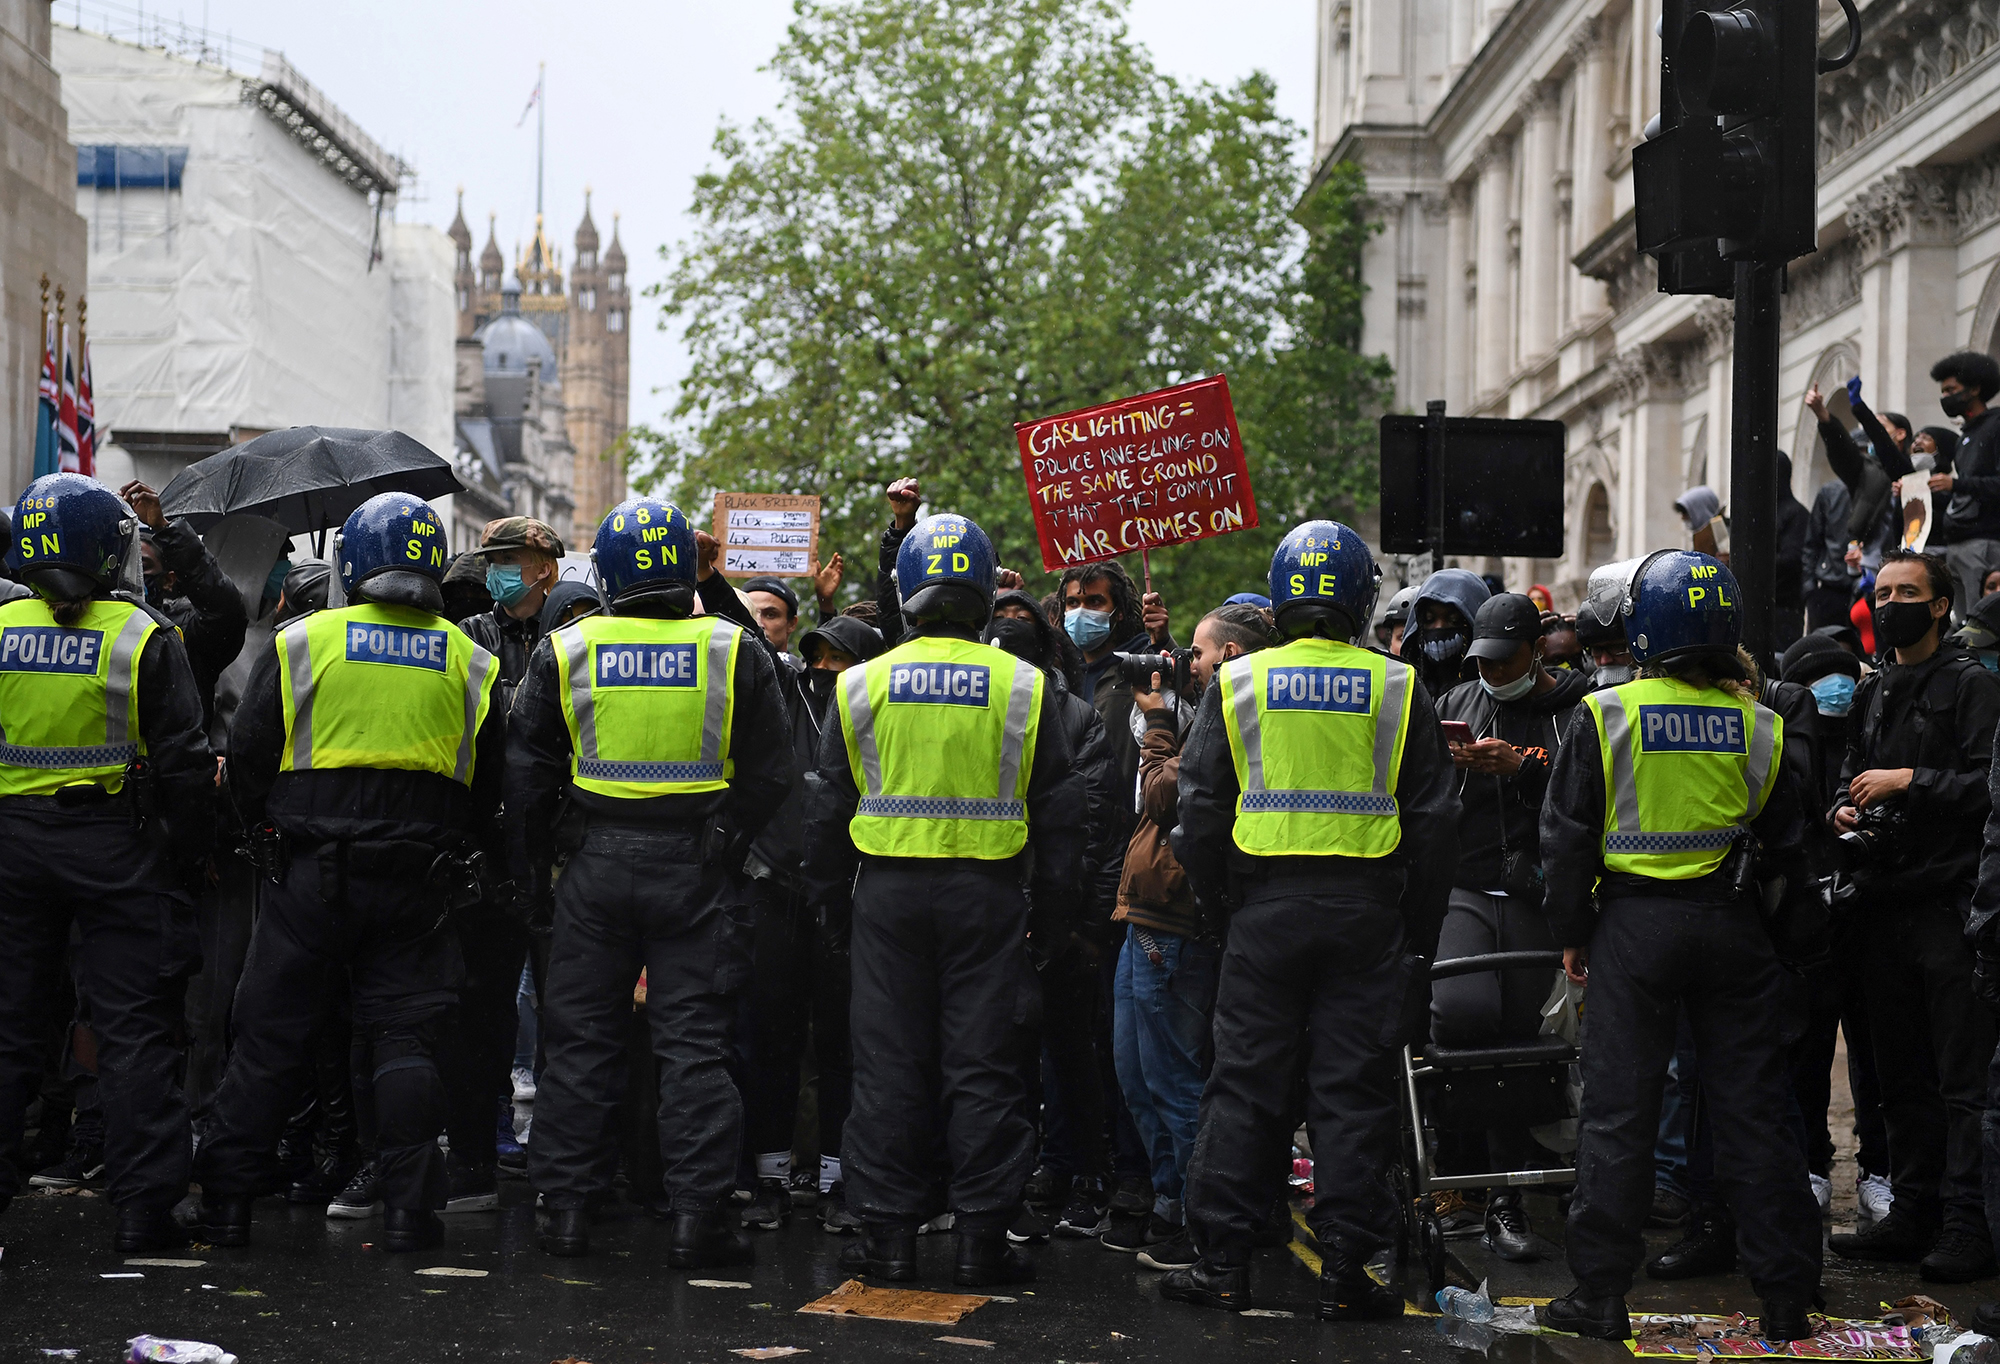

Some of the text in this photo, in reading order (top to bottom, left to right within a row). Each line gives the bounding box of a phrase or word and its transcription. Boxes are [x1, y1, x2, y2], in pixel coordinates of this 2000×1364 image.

[1028, 404, 1176, 457] GASLIGHTING
[1034, 426, 1231, 482] POLICE KNEELING ON
[1036, 453, 1218, 505] THE SAME GROUND
[21, 496, 55, 511] 1966
[724, 495, 818, 509] BLACK BRITS ARE
[1046, 472, 1237, 528] THAT THEY COMMIT
[23, 512, 47, 530] MP
[412, 520, 436, 538] MP
[642, 527, 668, 543] MP
[928, 524, 967, 534] 9439
[1053, 500, 1244, 565] WAR CRIMES ON
[933, 535, 960, 548] MP
[1300, 552, 1328, 567] MP
[1690, 566, 1718, 579] MP
[1, 632, 96, 667] POLICE
[351, 627, 443, 663] POLICE
[601, 650, 692, 679] POLICE
[893, 668, 984, 698] POLICE
[1272, 672, 1366, 705] POLICE
[1645, 712, 1741, 744] POLICE
